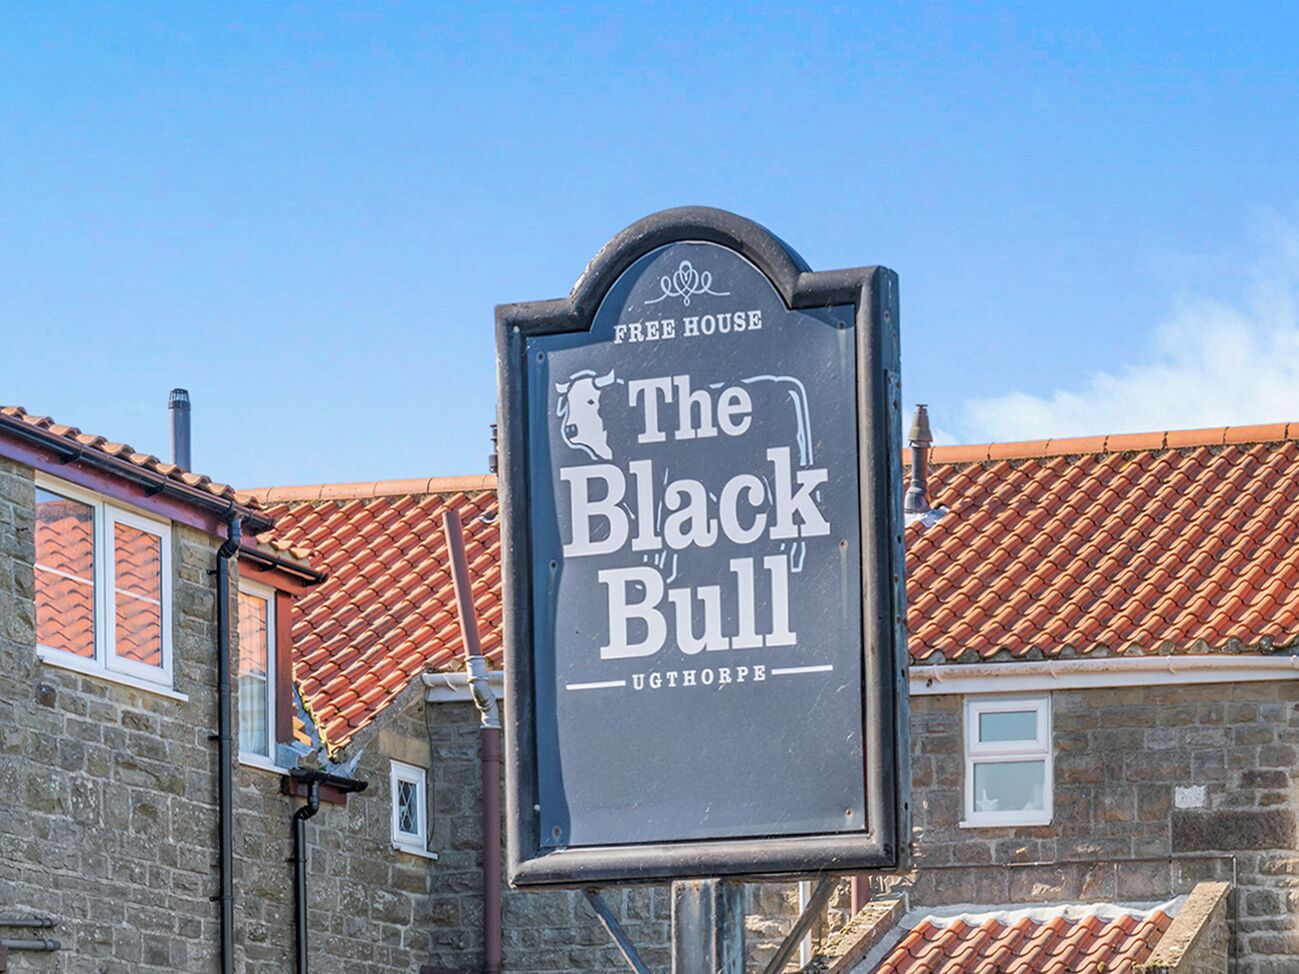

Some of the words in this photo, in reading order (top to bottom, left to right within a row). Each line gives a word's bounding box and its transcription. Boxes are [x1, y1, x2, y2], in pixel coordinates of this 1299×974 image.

[613, 318, 677, 345] FREE
[682, 310, 763, 338] HOUSE
[628, 374, 753, 443] The
[560, 446, 831, 559] Black
[598, 554, 798, 661] Bull
[631, 665, 767, 691] UGTHORPE
